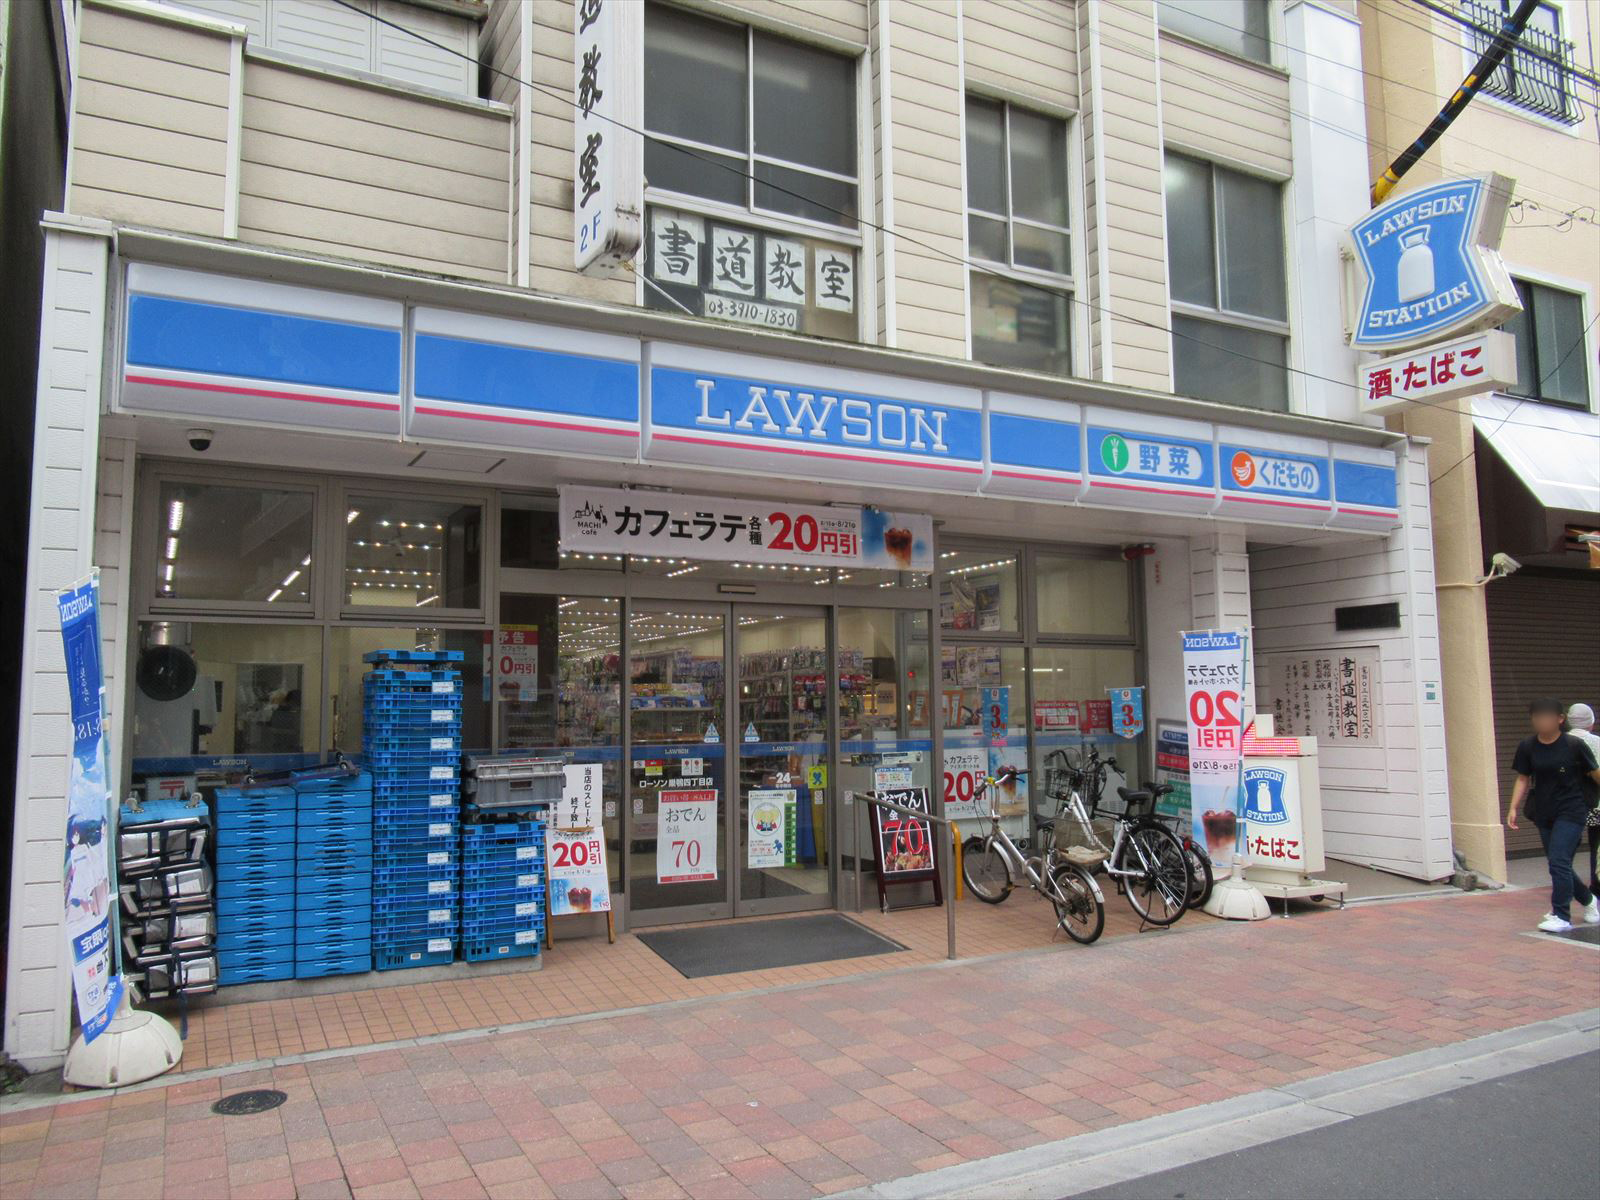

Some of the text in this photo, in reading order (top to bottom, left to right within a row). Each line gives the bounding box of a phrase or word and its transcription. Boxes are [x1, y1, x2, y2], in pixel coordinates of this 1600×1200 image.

[580, 210, 601, 254] 2F
[1364, 194, 1467, 247] LAWSON
[658, 221, 851, 303] 書道教室
[708, 299, 796, 329] 03-3910-1830
[1369, 281, 1473, 329] STATION
[695, 378, 949, 453] LAWSON
[1138, 444, 1190, 477] 野菜
[1259, 460, 1315, 490] くだもの
[577, 521, 602, 529] MACHI
[614, 506, 747, 543] カフェラテ
[1340, 657, 1359, 738] 書道教室
[949, 754, 979, 764] カフェラテ
[775, 772, 792, 784] 24
[1244, 770, 1283, 783] LAWSON
[583, 766, 592, 828] 当店のスピード
[665, 807, 706, 823] おでん
[1246, 810, 1285, 823] STATION
[671, 839, 701, 868] 70
[882, 819, 924, 857] 70
[1245, 835, 1300, 861] ・たばこ
